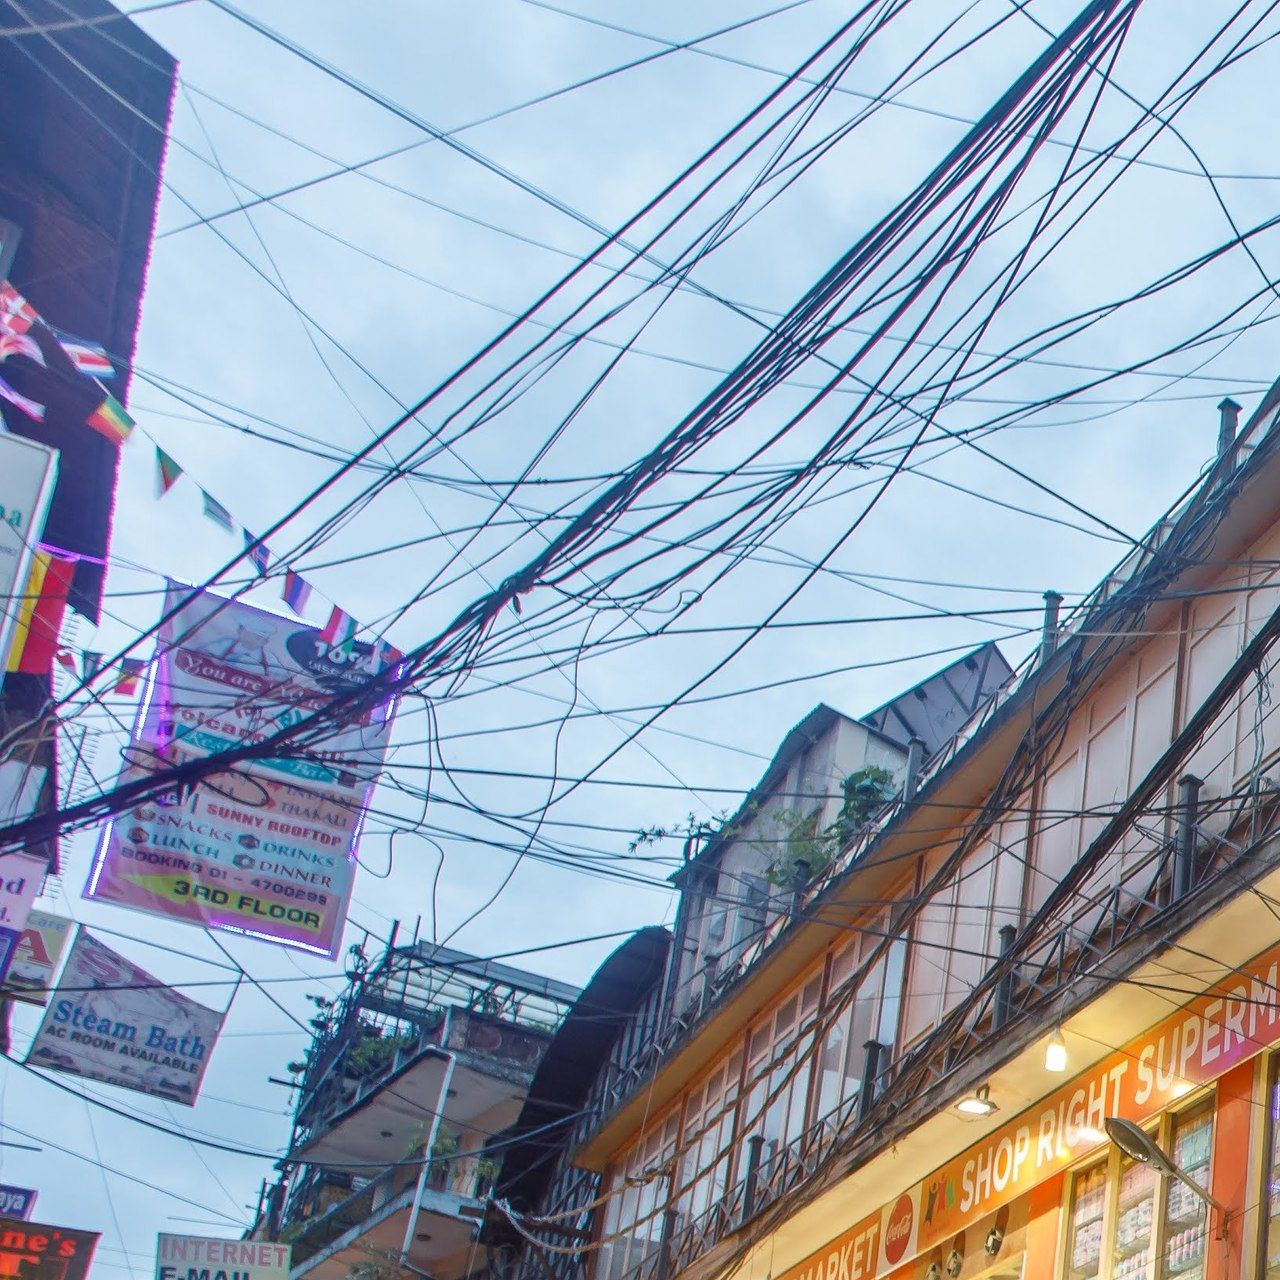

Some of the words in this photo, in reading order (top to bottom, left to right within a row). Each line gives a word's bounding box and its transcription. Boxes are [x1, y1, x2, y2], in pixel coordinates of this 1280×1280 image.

[184, 652, 227, 682] You
[156, 811, 233, 842] SNACKS
[206, 803, 263, 828] SUNNY
[267, 820, 343, 848] ROOFTOP
[121, 847, 203, 874] BOOKING
[152, 833, 220, 860] LUNCH
[263, 841, 336, 869] DRINKS
[259, 860, 332, 889] DINNER
[173, 879, 230, 905] 3RD
[237, 895, 322, 929] FLOOR
[52, 999, 138, 1042] Steam
[144, 1026, 207, 1060] Bath
[44, 1026, 67, 1039] AC
[70, 1030, 117, 1053] ROOM
[119, 1044, 200, 1074] AVAILABLE
[959, 1125, 1030, 1214] SHOP
[1036, 1066, 1127, 1170] RIGHT
[161, 1238, 289, 1268] INTERNET
